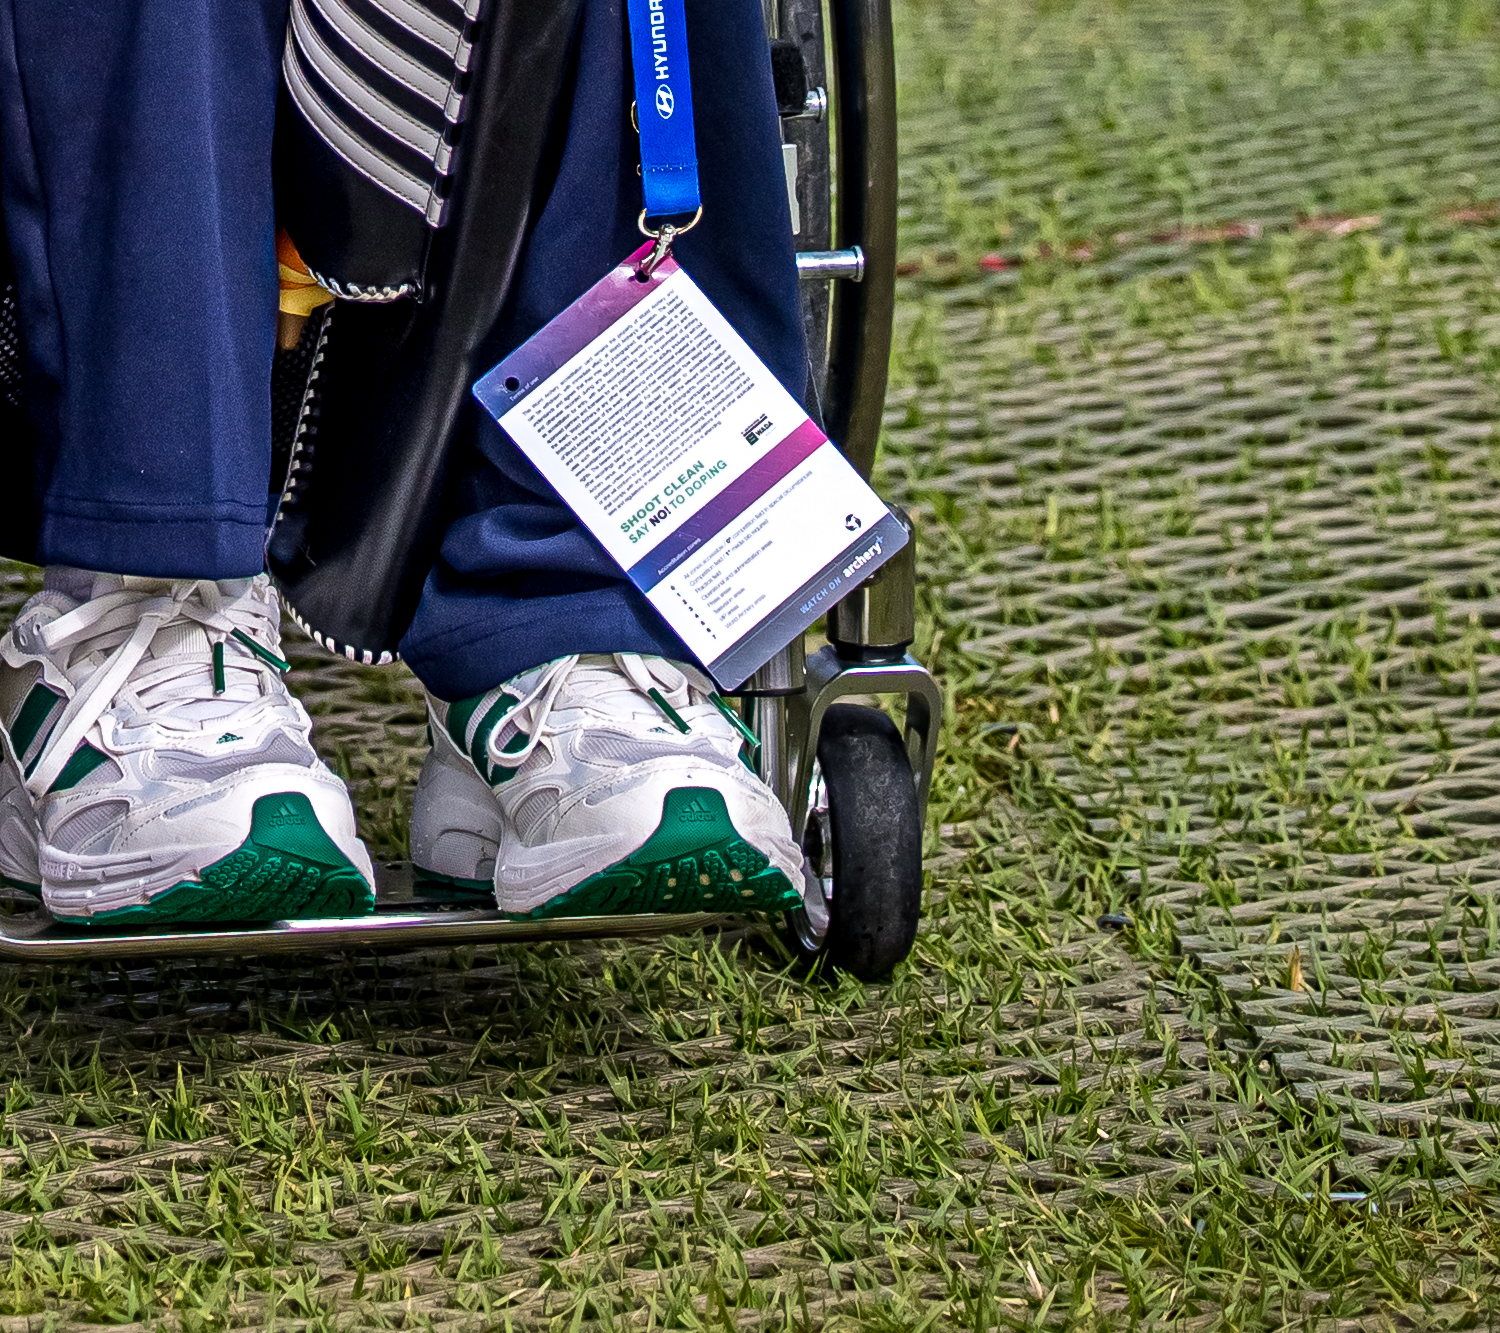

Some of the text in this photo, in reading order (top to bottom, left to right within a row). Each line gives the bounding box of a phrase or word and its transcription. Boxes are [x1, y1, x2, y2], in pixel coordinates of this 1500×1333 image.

[618, 458, 706, 534] SHOOT CLEAN
[627, 457, 728, 544] SAY NO! TO DOPING
[798, 586, 830, 615] WATCH
[827, 575, 843, 590] ON
